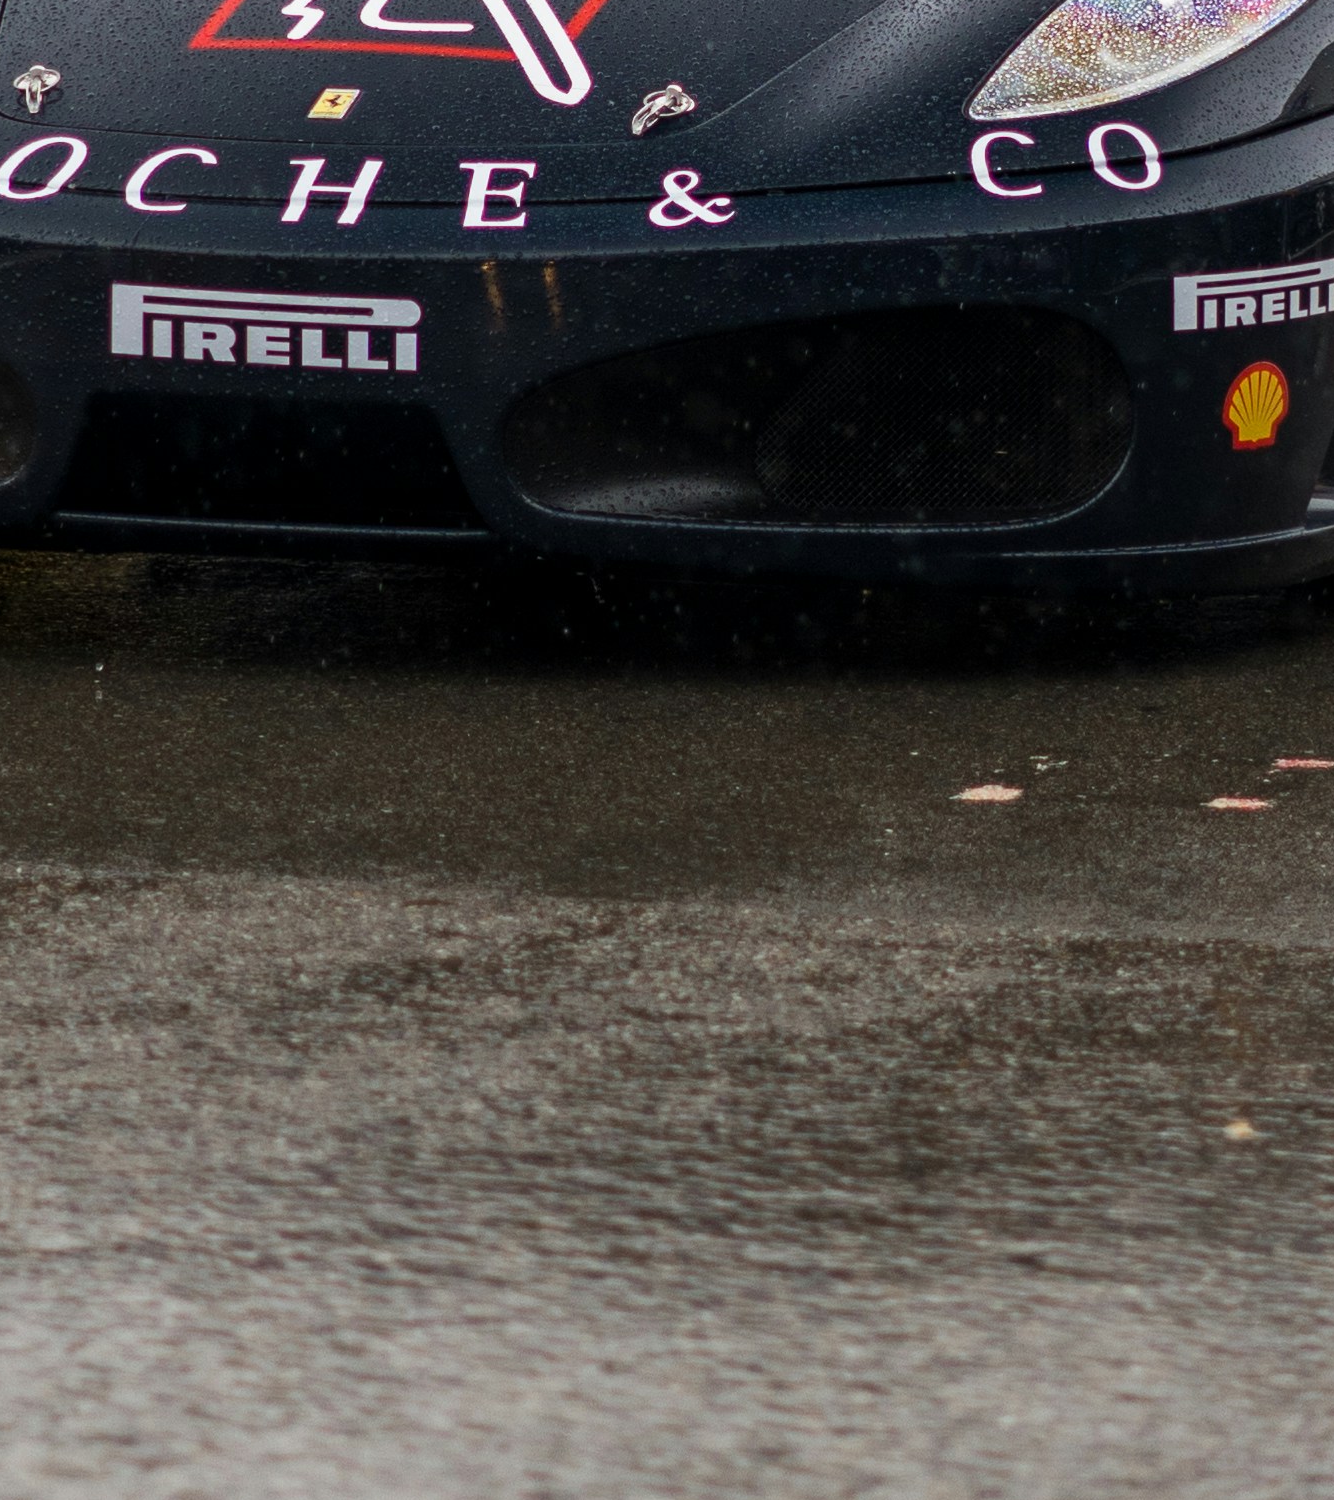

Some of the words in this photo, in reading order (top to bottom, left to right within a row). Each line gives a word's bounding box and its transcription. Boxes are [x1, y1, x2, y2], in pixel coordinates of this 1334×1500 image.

[648, 170, 735, 228] &
[970, 123, 1162, 198] CO
[111, 283, 423, 371] PIRELLI
